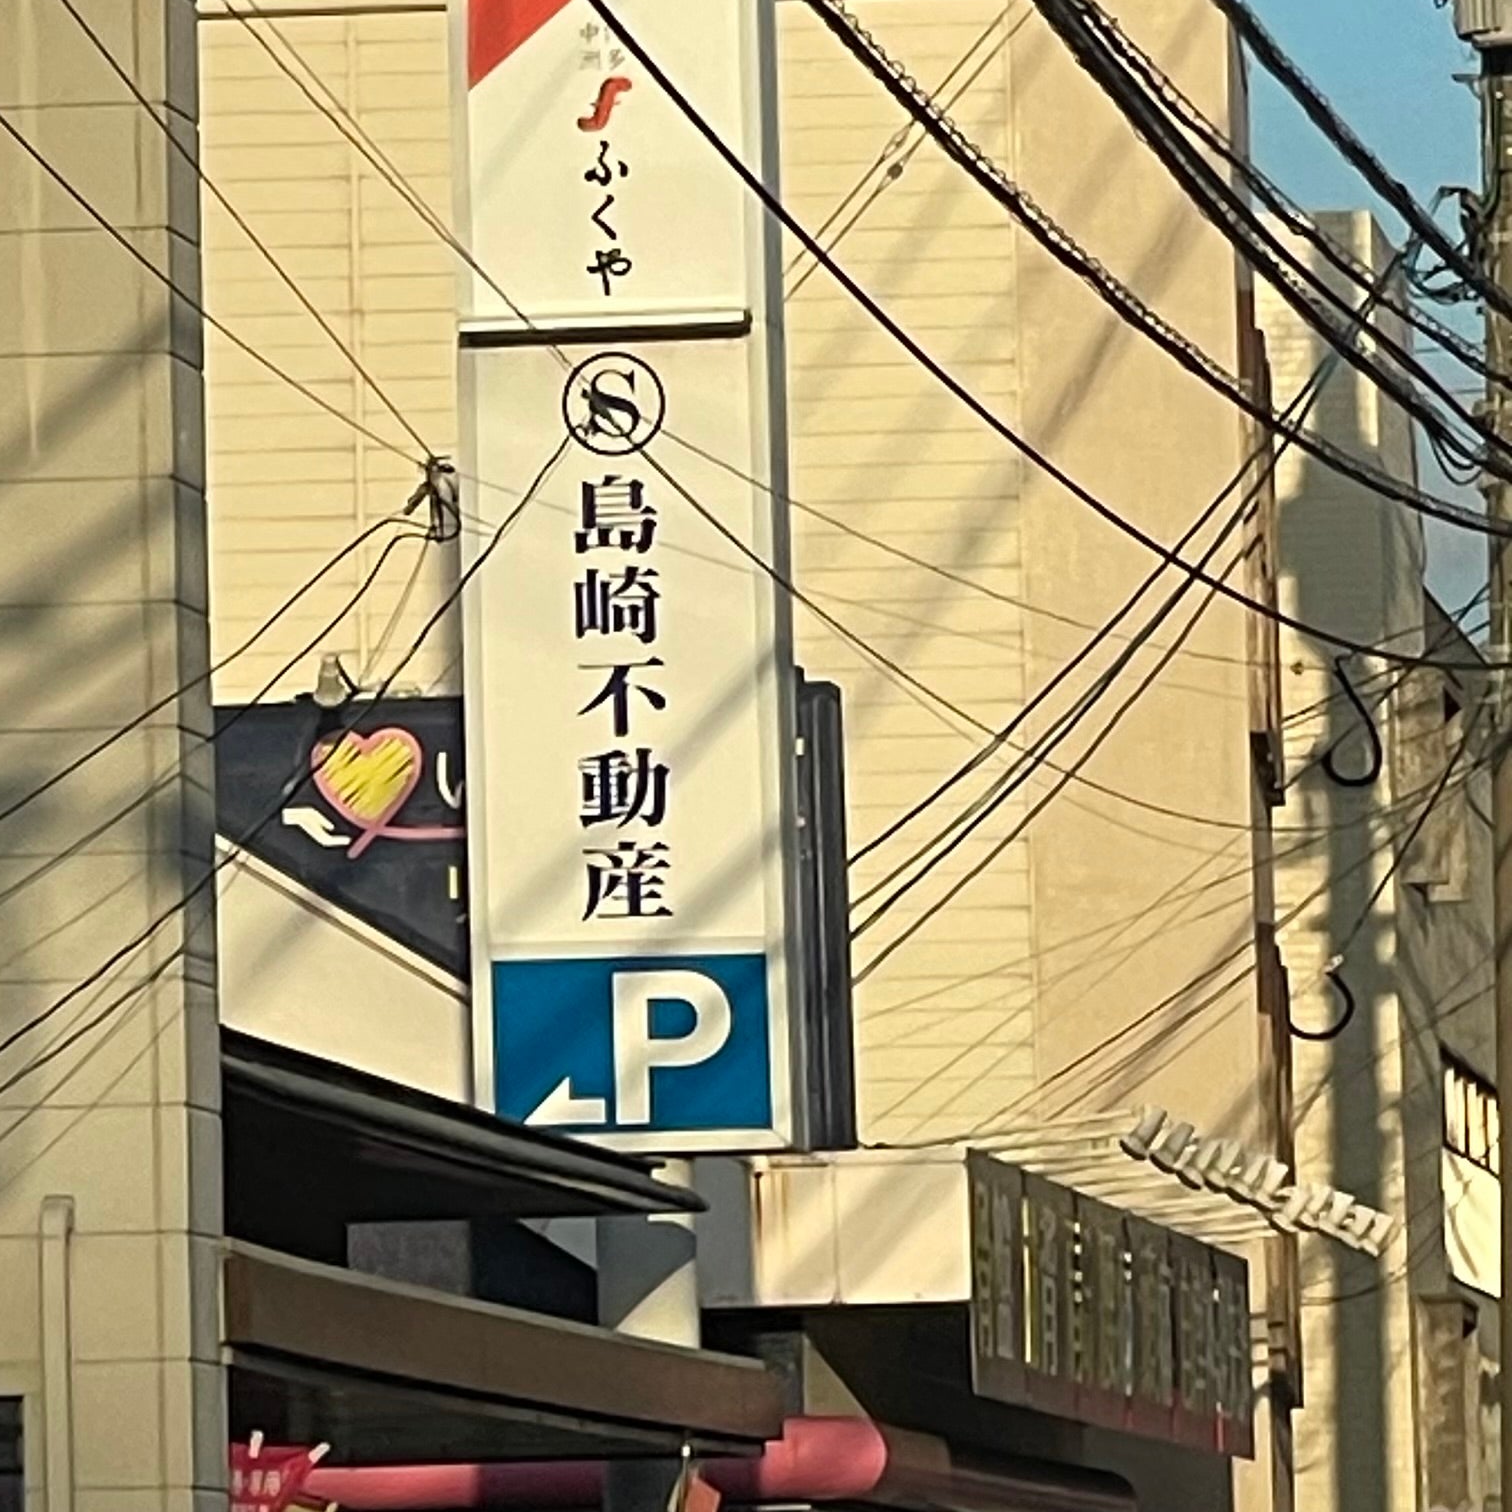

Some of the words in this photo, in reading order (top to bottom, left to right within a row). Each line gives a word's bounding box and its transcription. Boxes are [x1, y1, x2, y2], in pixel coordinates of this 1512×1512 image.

[584, 140, 632, 296] ふくや
[574, 474, 674, 922] 島崎不動産
[612, 969, 732, 1125] P
